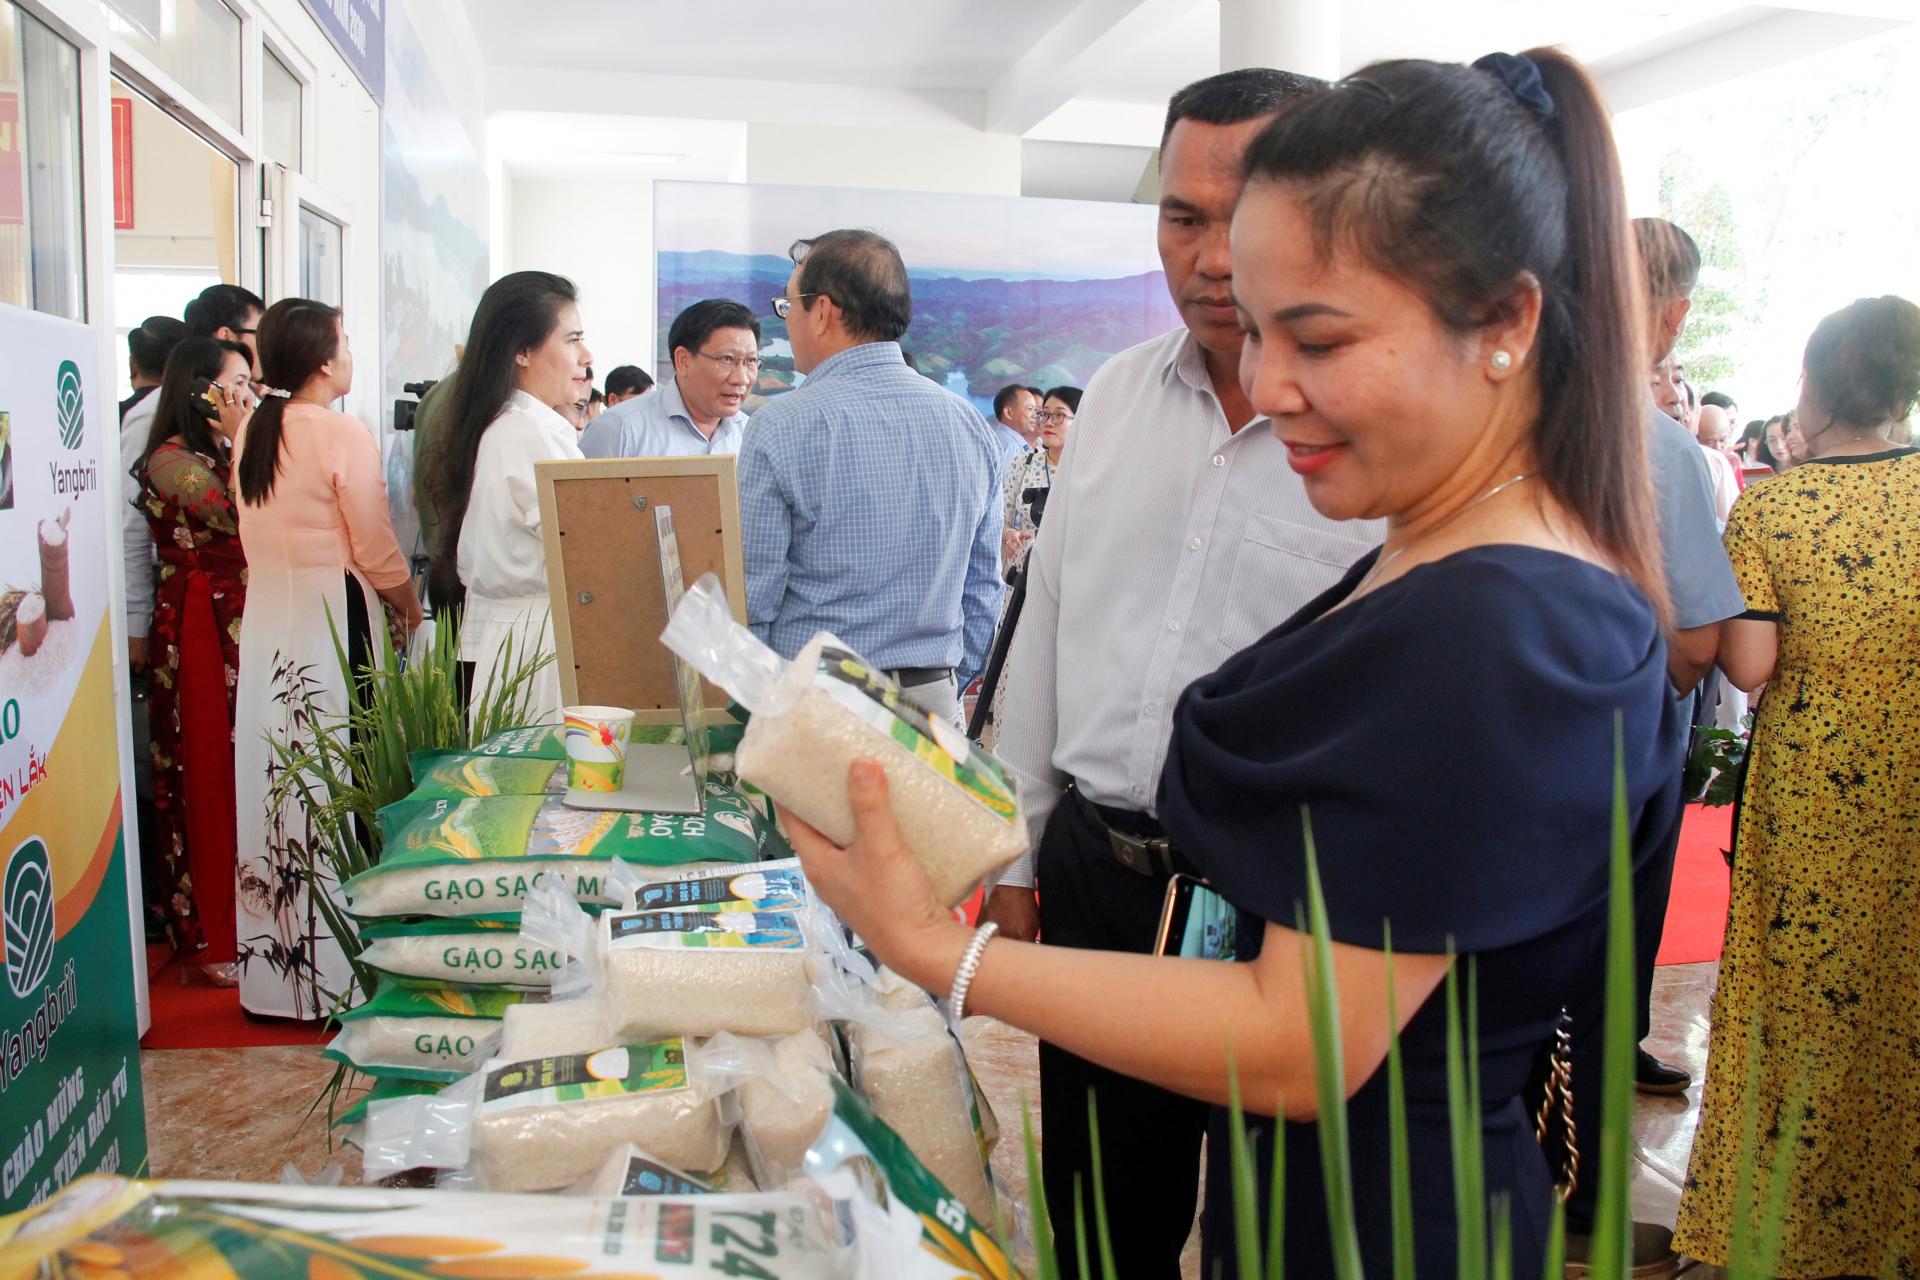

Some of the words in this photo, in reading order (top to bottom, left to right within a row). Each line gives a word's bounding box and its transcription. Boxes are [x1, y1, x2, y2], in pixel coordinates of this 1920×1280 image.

[49, 458, 97, 501] Yangbrii
[19, 744, 47, 795] LẮK
[424, 878, 484, 905] GẠO
[443, 948, 503, 974] GẠO
[415, 1034, 475, 1060] GẠO
[3, 1124, 45, 1200] CHÀO
[46, 1065, 85, 1142] MỪNG
[54, 1124, 87, 1190] TIẾN
[112, 1055, 128, 1109] TƯ
